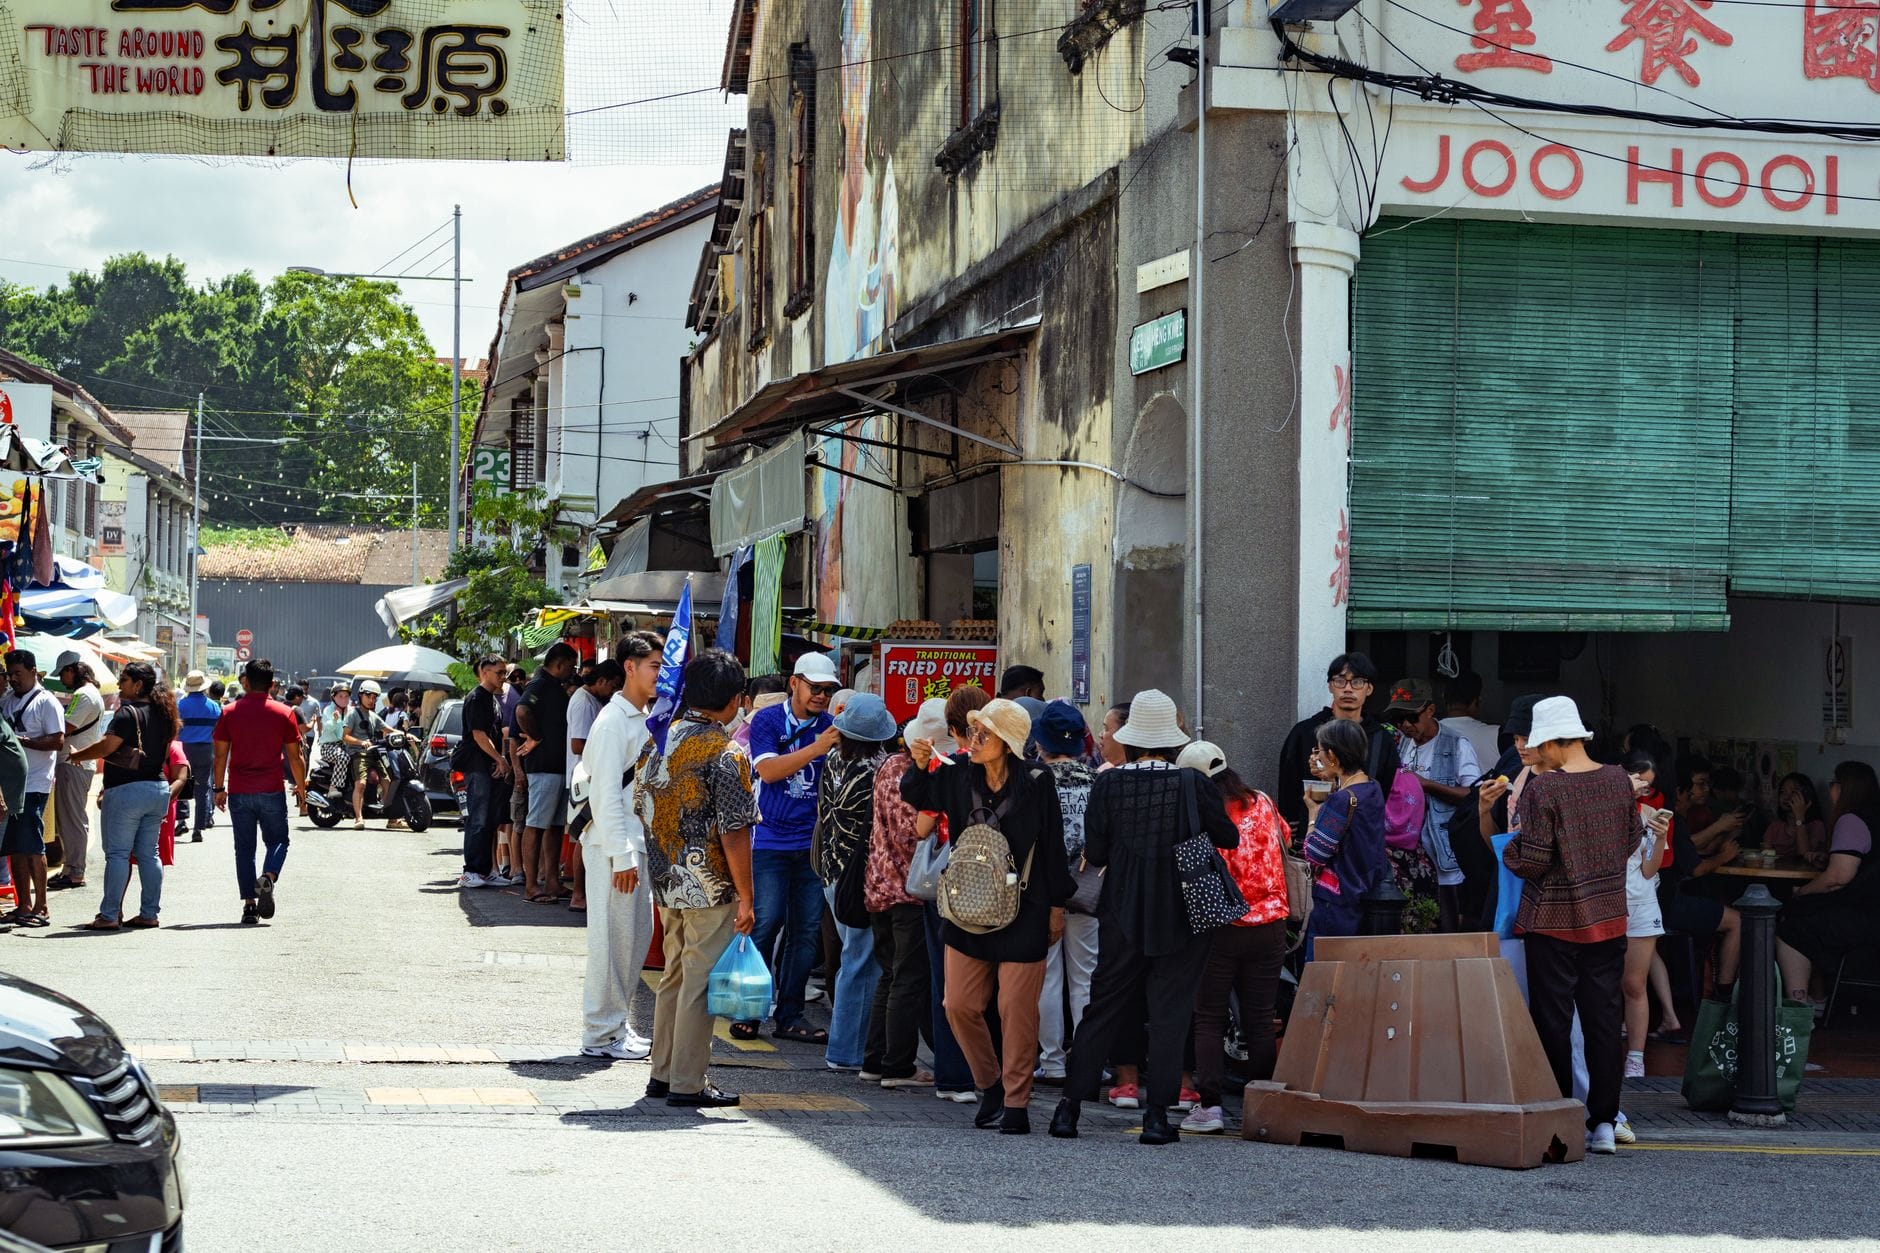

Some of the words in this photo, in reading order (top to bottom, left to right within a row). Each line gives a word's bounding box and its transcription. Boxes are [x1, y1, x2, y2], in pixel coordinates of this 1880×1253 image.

[24, 24, 108, 58] TASTE
[118, 27, 206, 61] AROUND
[79, 63, 130, 95] THE
[135, 64, 206, 97] WORLD
[1400, 134, 1584, 201] JOO
[1626, 145, 1839, 216] HOOI
[106, 531, 119, 539] DV
[915, 651, 977, 660] TRADITIONAL
[888, 660, 937, 676] FRIED
[943, 660, 997, 677] OYSTE
